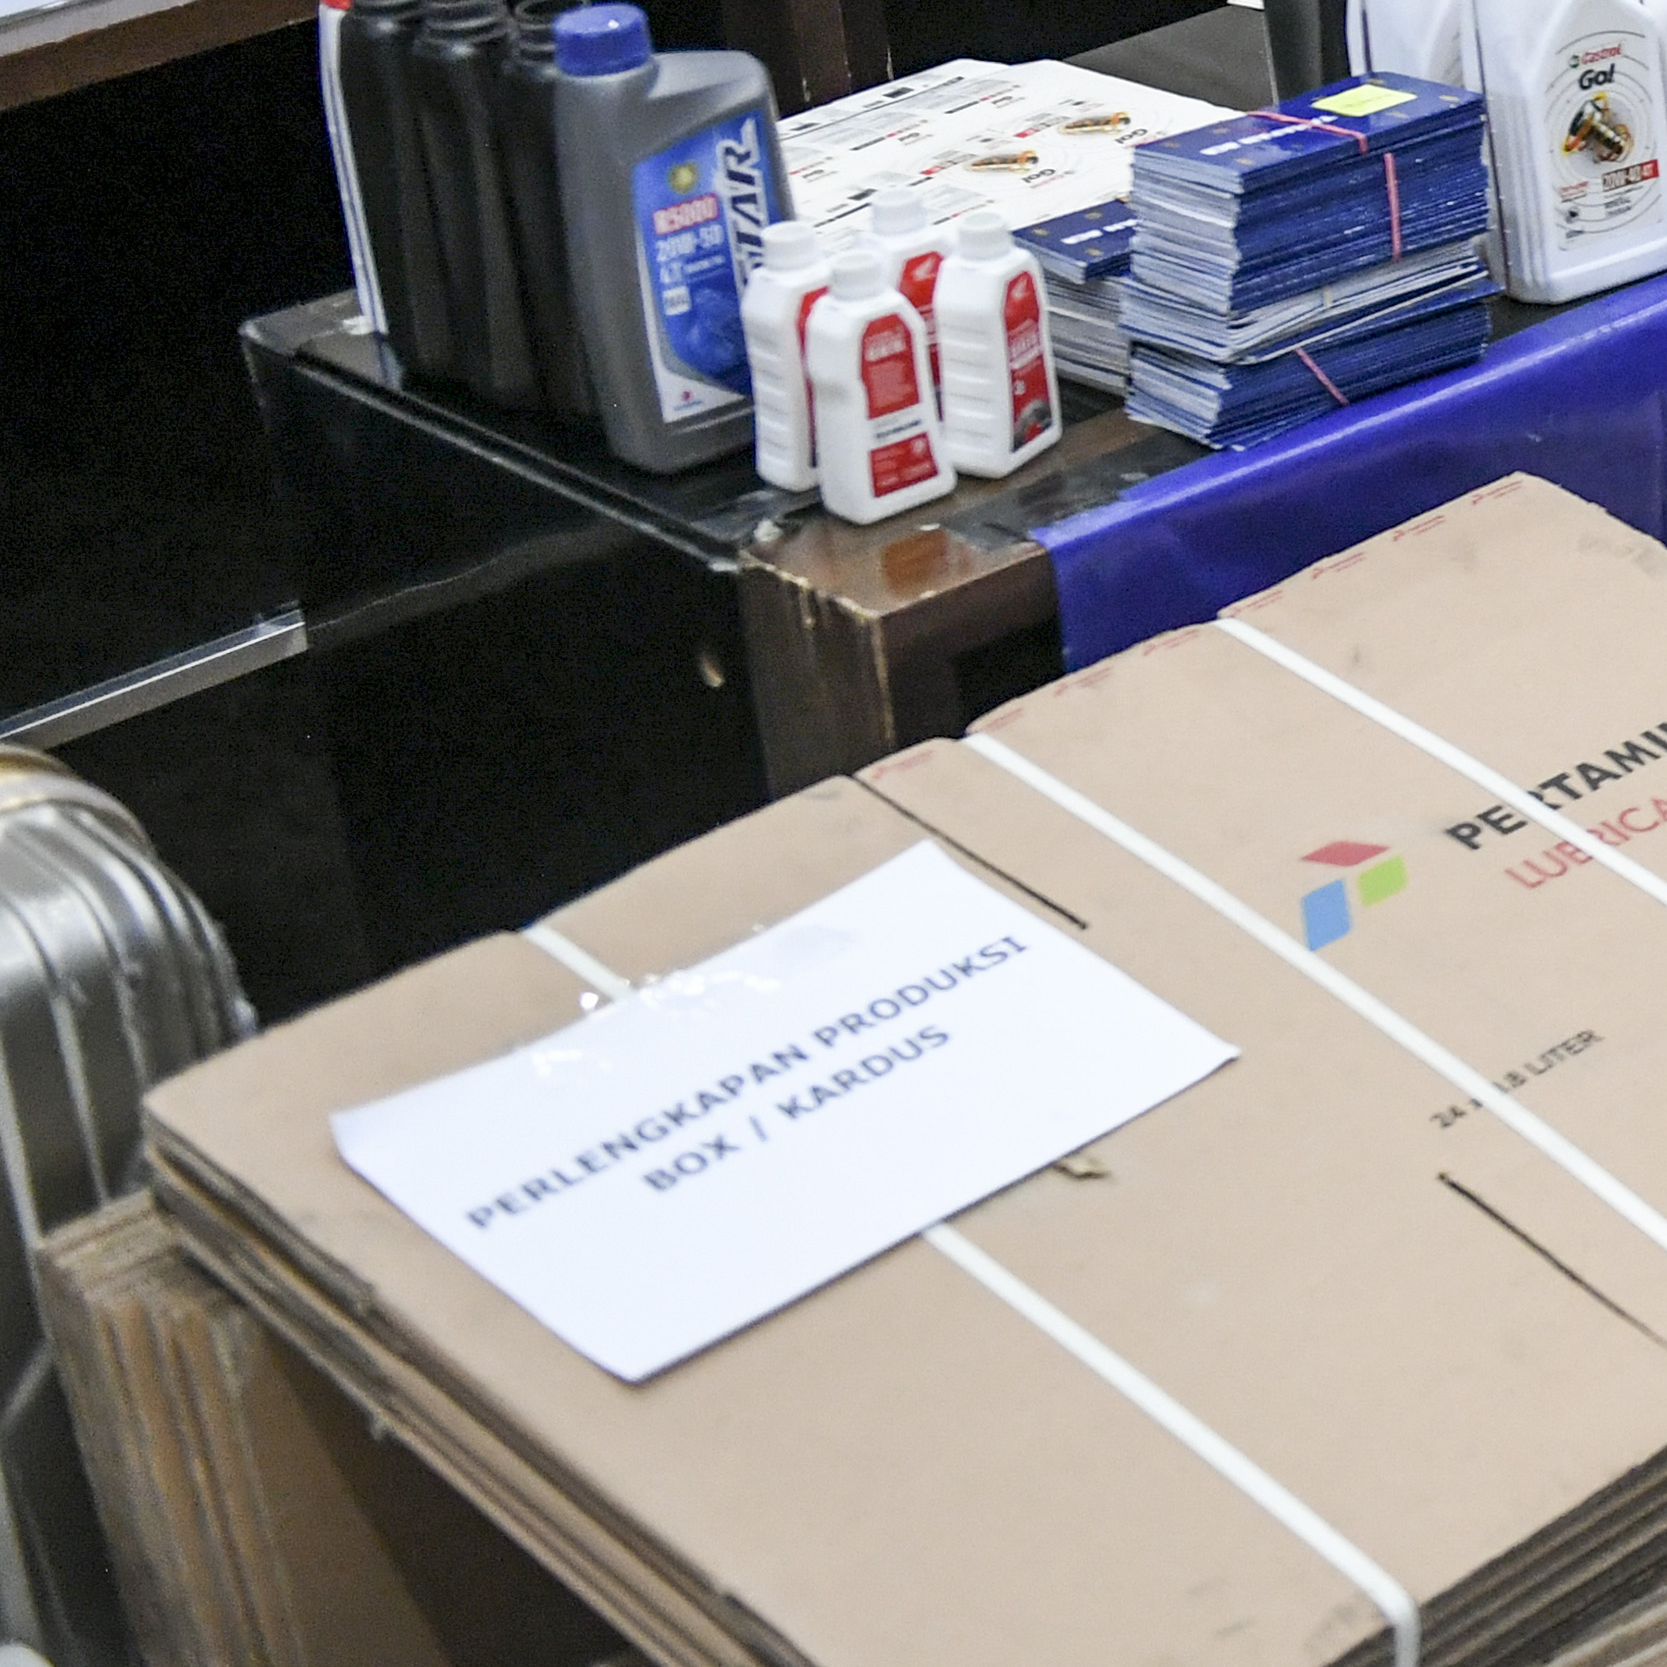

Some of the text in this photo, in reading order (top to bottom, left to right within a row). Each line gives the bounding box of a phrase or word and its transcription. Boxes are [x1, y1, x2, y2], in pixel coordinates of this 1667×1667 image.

[1581, 44, 1622, 65] Castrol
[1578, 63, 1616, 90] Go!
[1602, 163, 1641, 192] 20W-40
[1524, 1030, 1605, 1075] LITER
[465, 932, 1032, 1234] PERLENGKAPAN PRODUKSI
[640, 1134, 741, 1195] BOX
[776, 1022, 953, 1125] KARDUS
